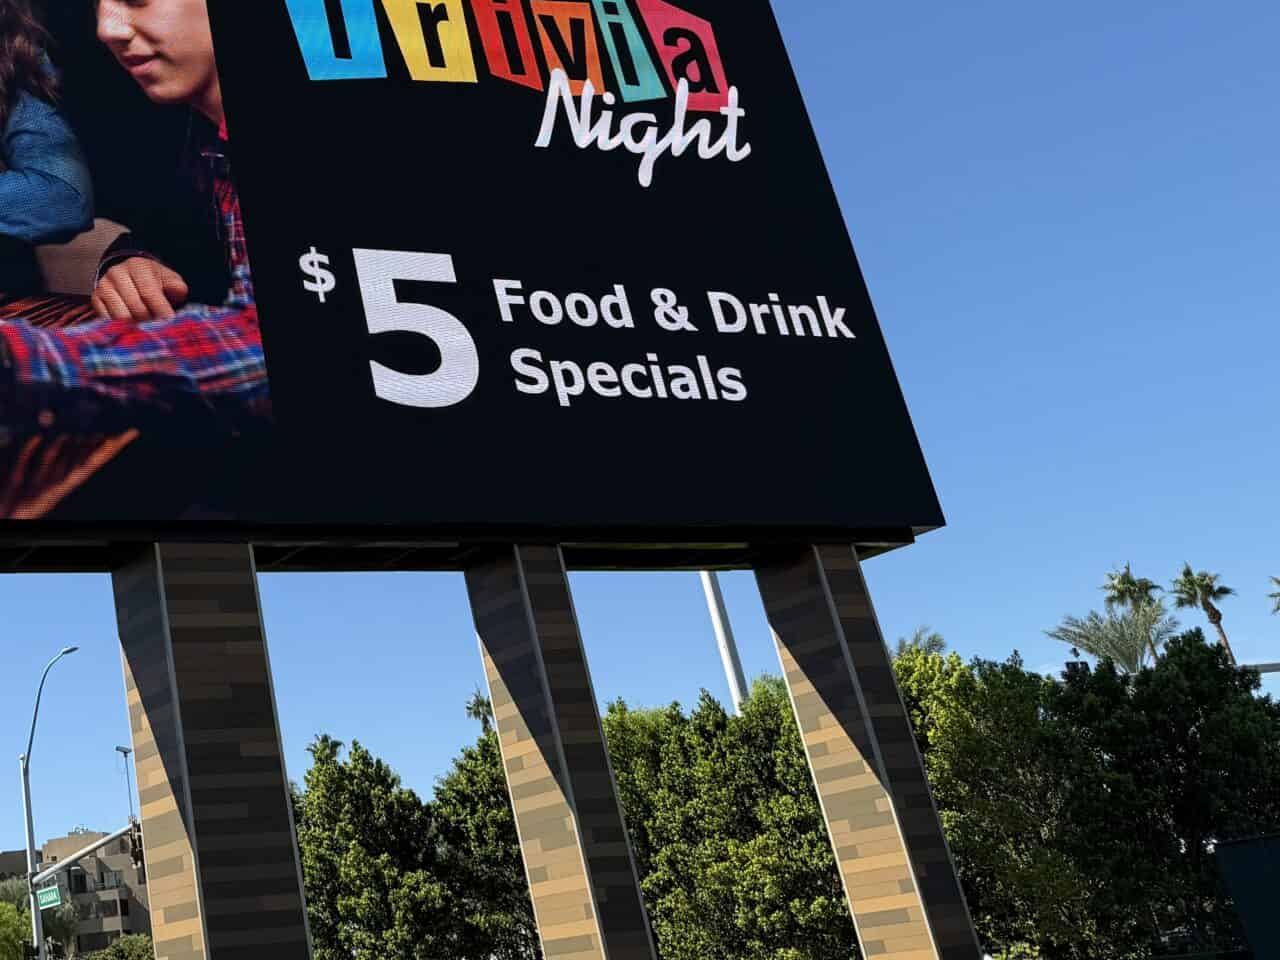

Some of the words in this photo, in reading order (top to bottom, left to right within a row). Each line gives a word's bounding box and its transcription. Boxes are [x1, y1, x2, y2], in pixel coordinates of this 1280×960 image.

[534, 67, 752, 187] Night
[492, 278, 635, 330] Food
[652, 287, 698, 332] &
[706, 290, 857, 340] Drink
[509, 347, 748, 407] Specials
